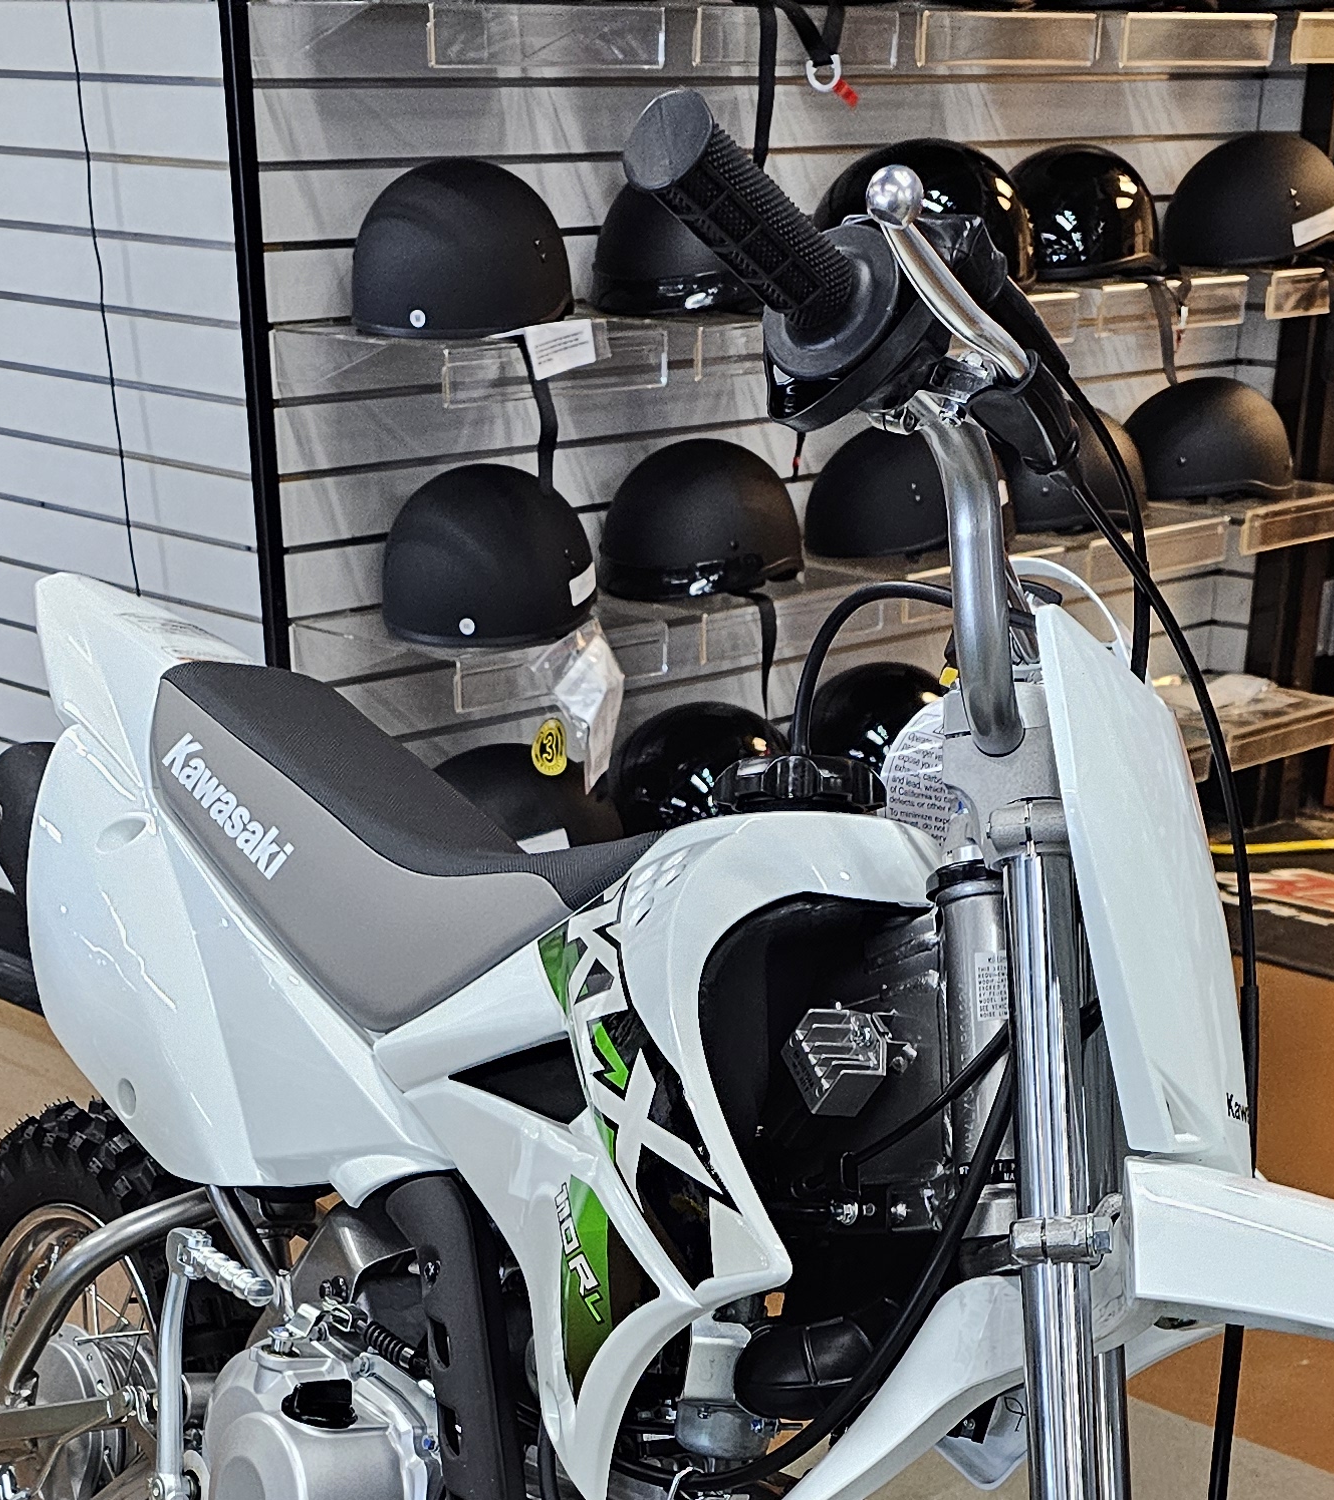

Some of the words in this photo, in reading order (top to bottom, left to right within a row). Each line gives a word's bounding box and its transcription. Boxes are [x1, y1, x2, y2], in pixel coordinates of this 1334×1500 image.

[542, 731, 555, 763] 3
[891, 775, 905, 785] and
[890, 785, 898, 794] of
[898, 786, 933, 800] California
[934, 794, 942, 803] to
[160, 732, 295, 882] Kawasaki
[889, 807, 898, 817] To
[900, 810, 933, 822] minimize
